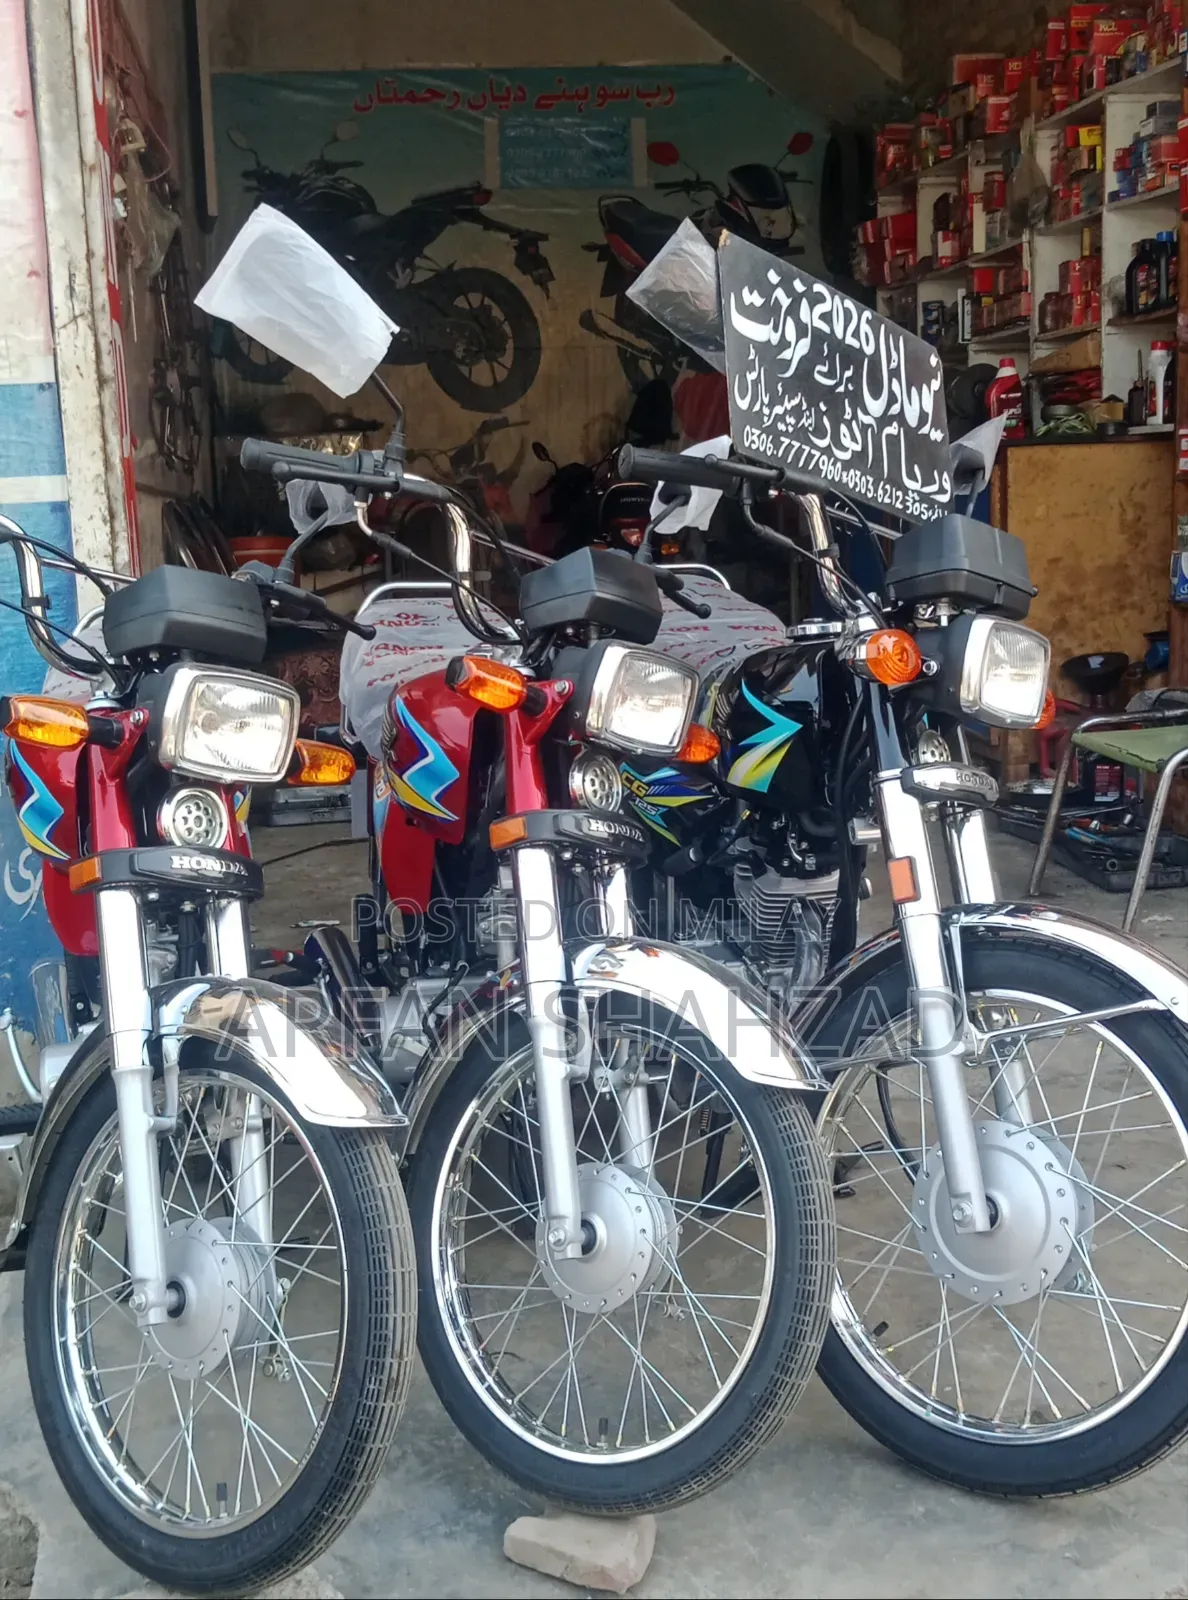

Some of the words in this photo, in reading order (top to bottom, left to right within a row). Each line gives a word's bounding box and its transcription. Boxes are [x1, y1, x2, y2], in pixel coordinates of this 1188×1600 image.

[352, 79, 460, 113] رحمتاں
[467, 78, 527, 111] دیاں
[635, 81, 676, 107] رب
[730, 268, 812, 378] فروخت
[811, 283, 876, 356] 2026
[813, 342, 854, 393] برائے
[862, 323, 919, 428] ماڈل
[621, 771, 650, 798] CG
[634, 797, 658, 816] 125
[589, 818, 645, 842] HONDA
[170, 855, 249, 877] HONDA
